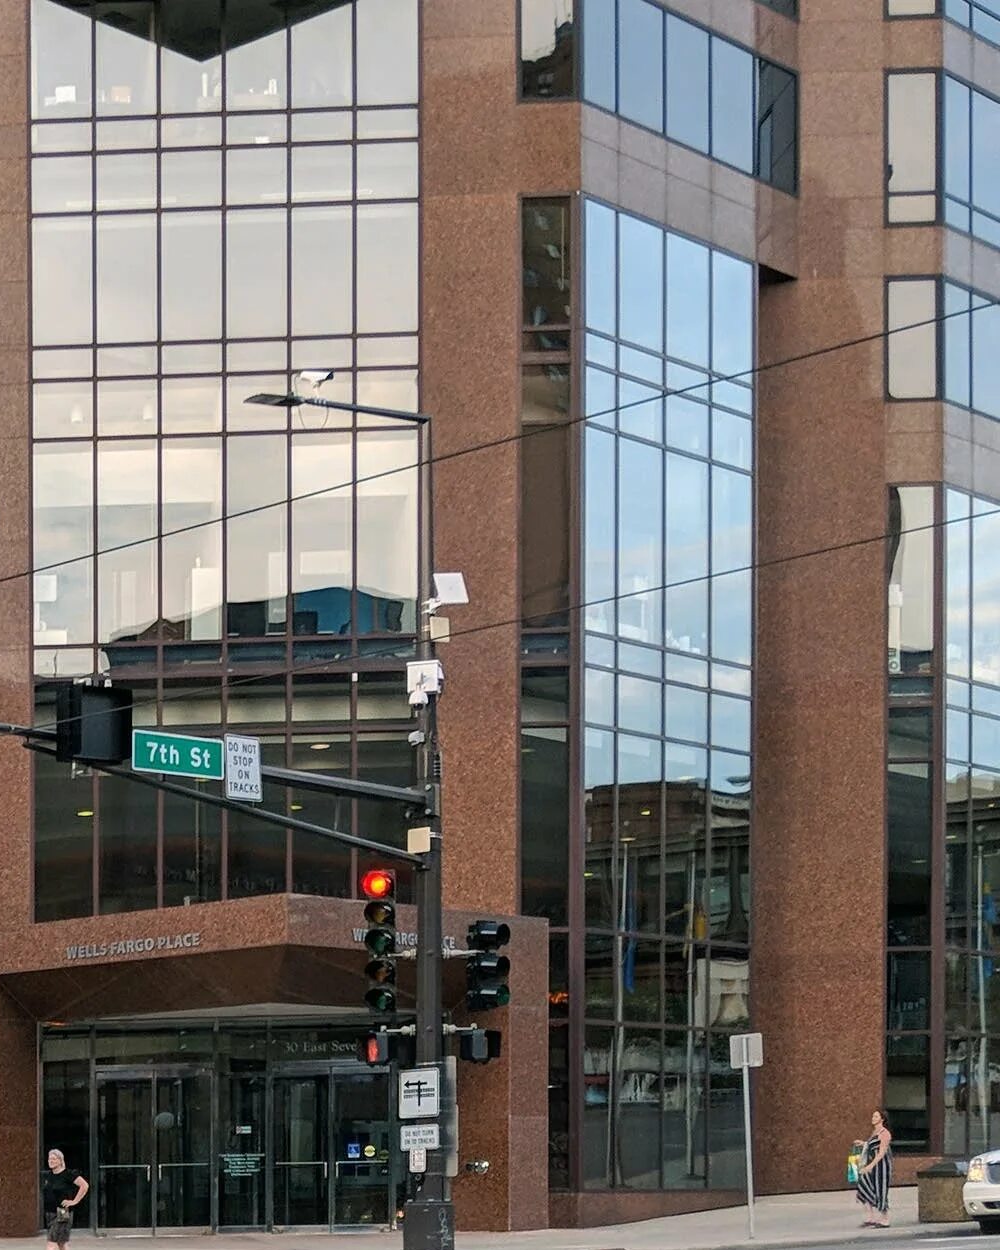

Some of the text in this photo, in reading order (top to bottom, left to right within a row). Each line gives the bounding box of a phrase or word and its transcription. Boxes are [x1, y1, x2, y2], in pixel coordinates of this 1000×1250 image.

[228, 741, 257, 755] DO NOT
[146, 741, 211, 769] 7th St
[233, 755, 254, 766] STOP
[238, 769, 250, 780] ON
[229, 781, 260, 794] TRACKS
[66, 932, 201, 960] WELLS FARGO PLACE
